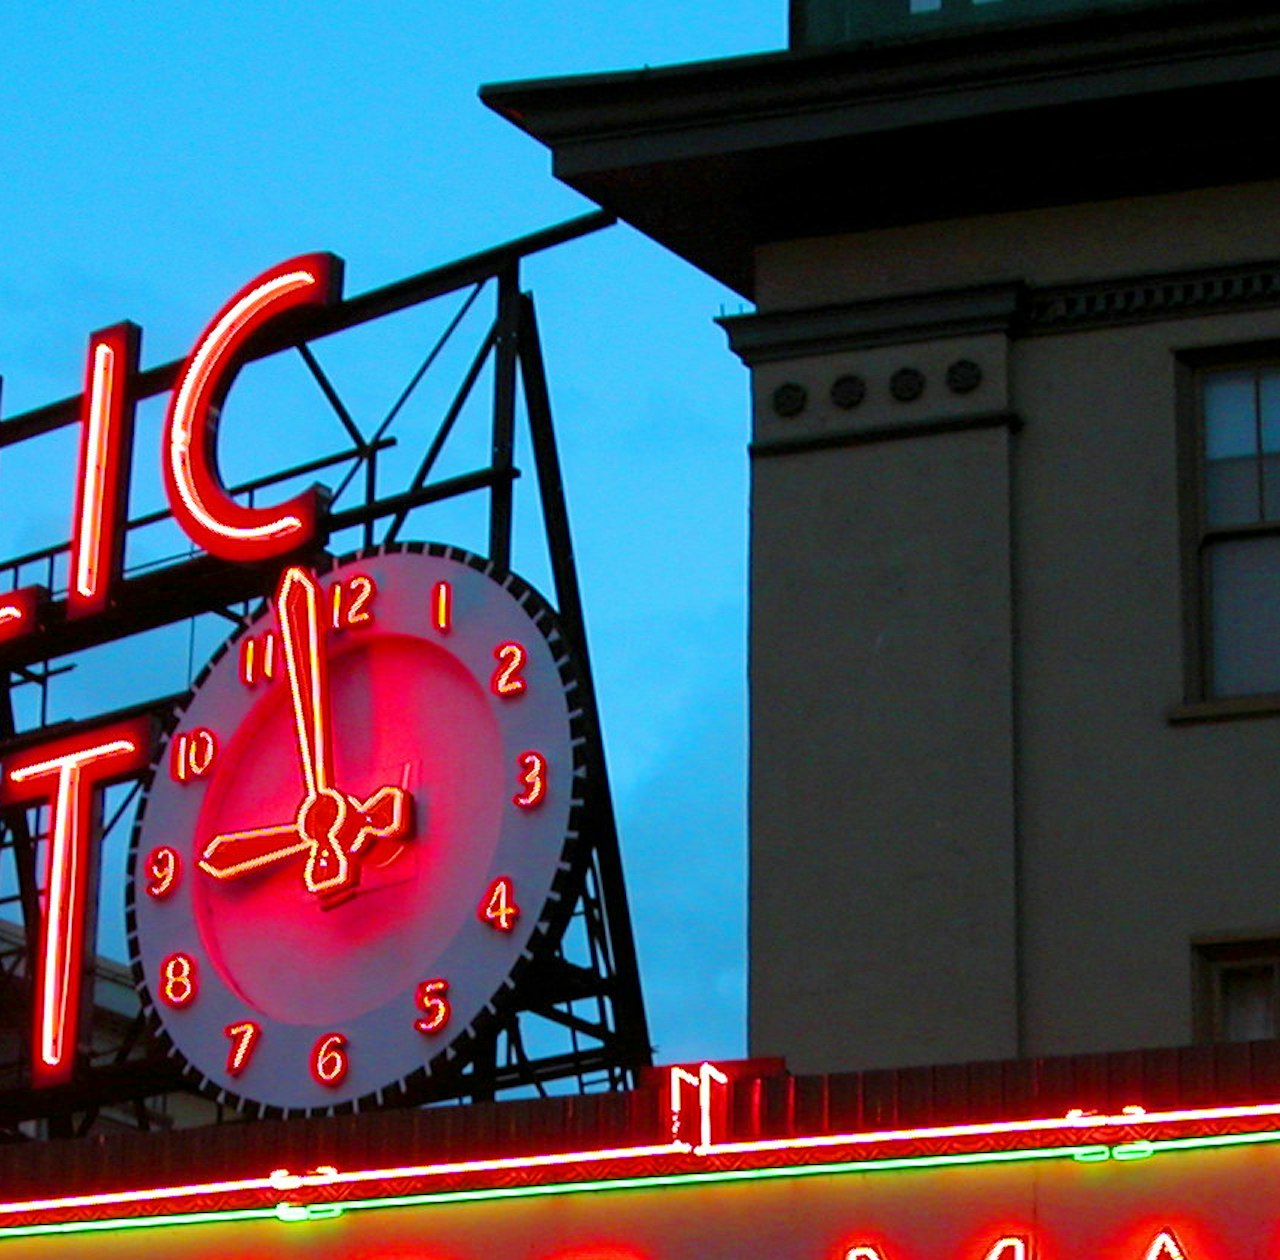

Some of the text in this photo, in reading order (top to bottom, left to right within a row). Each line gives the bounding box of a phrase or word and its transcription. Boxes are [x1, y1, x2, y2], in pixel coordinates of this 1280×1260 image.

[329, 575, 375, 629] 12
[434, 582, 451, 629] 1
[242, 633, 275, 684] 11
[495, 643, 525, 695] 2
[175, 730, 216, 781] 10
[515, 753, 544, 807] 3
[147, 846, 178, 896] 9
[482, 878, 517, 931] 4
[161, 955, 195, 1005] 8
[416, 979, 448, 1033] 5
[226, 1022, 258, 1073] 7
[314, 1034, 347, 1084] 6
